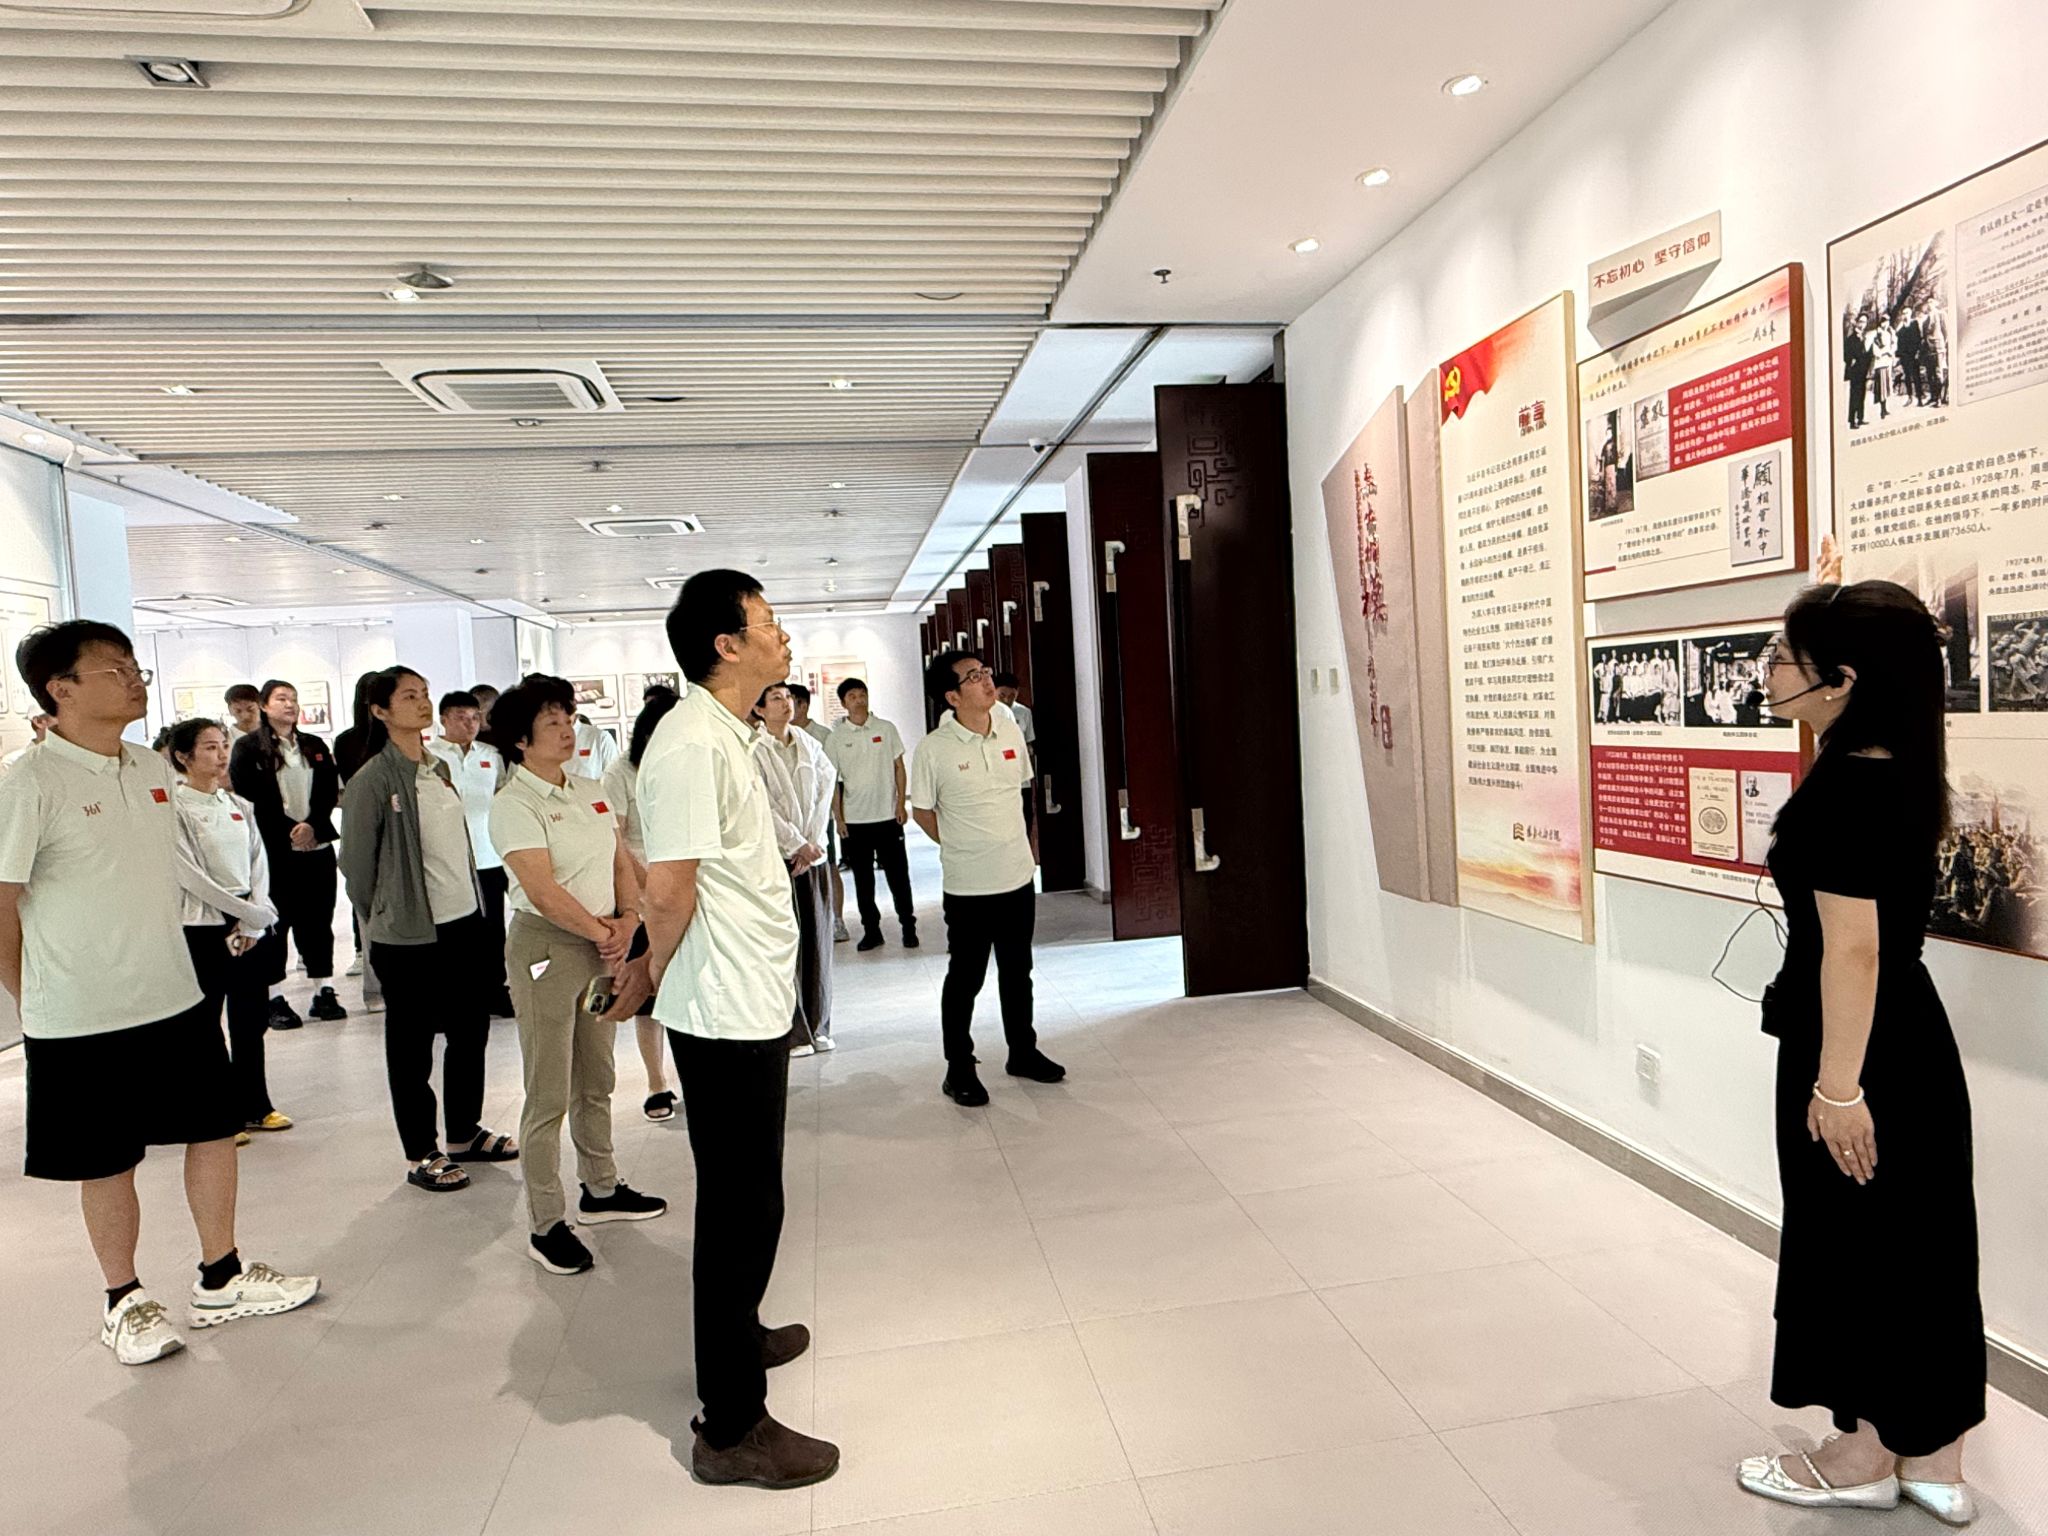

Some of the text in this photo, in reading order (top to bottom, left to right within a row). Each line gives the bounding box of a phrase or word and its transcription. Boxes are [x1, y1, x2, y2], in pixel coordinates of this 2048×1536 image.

[1593, 231, 1711, 288] 不忘初心 坚守信仰
